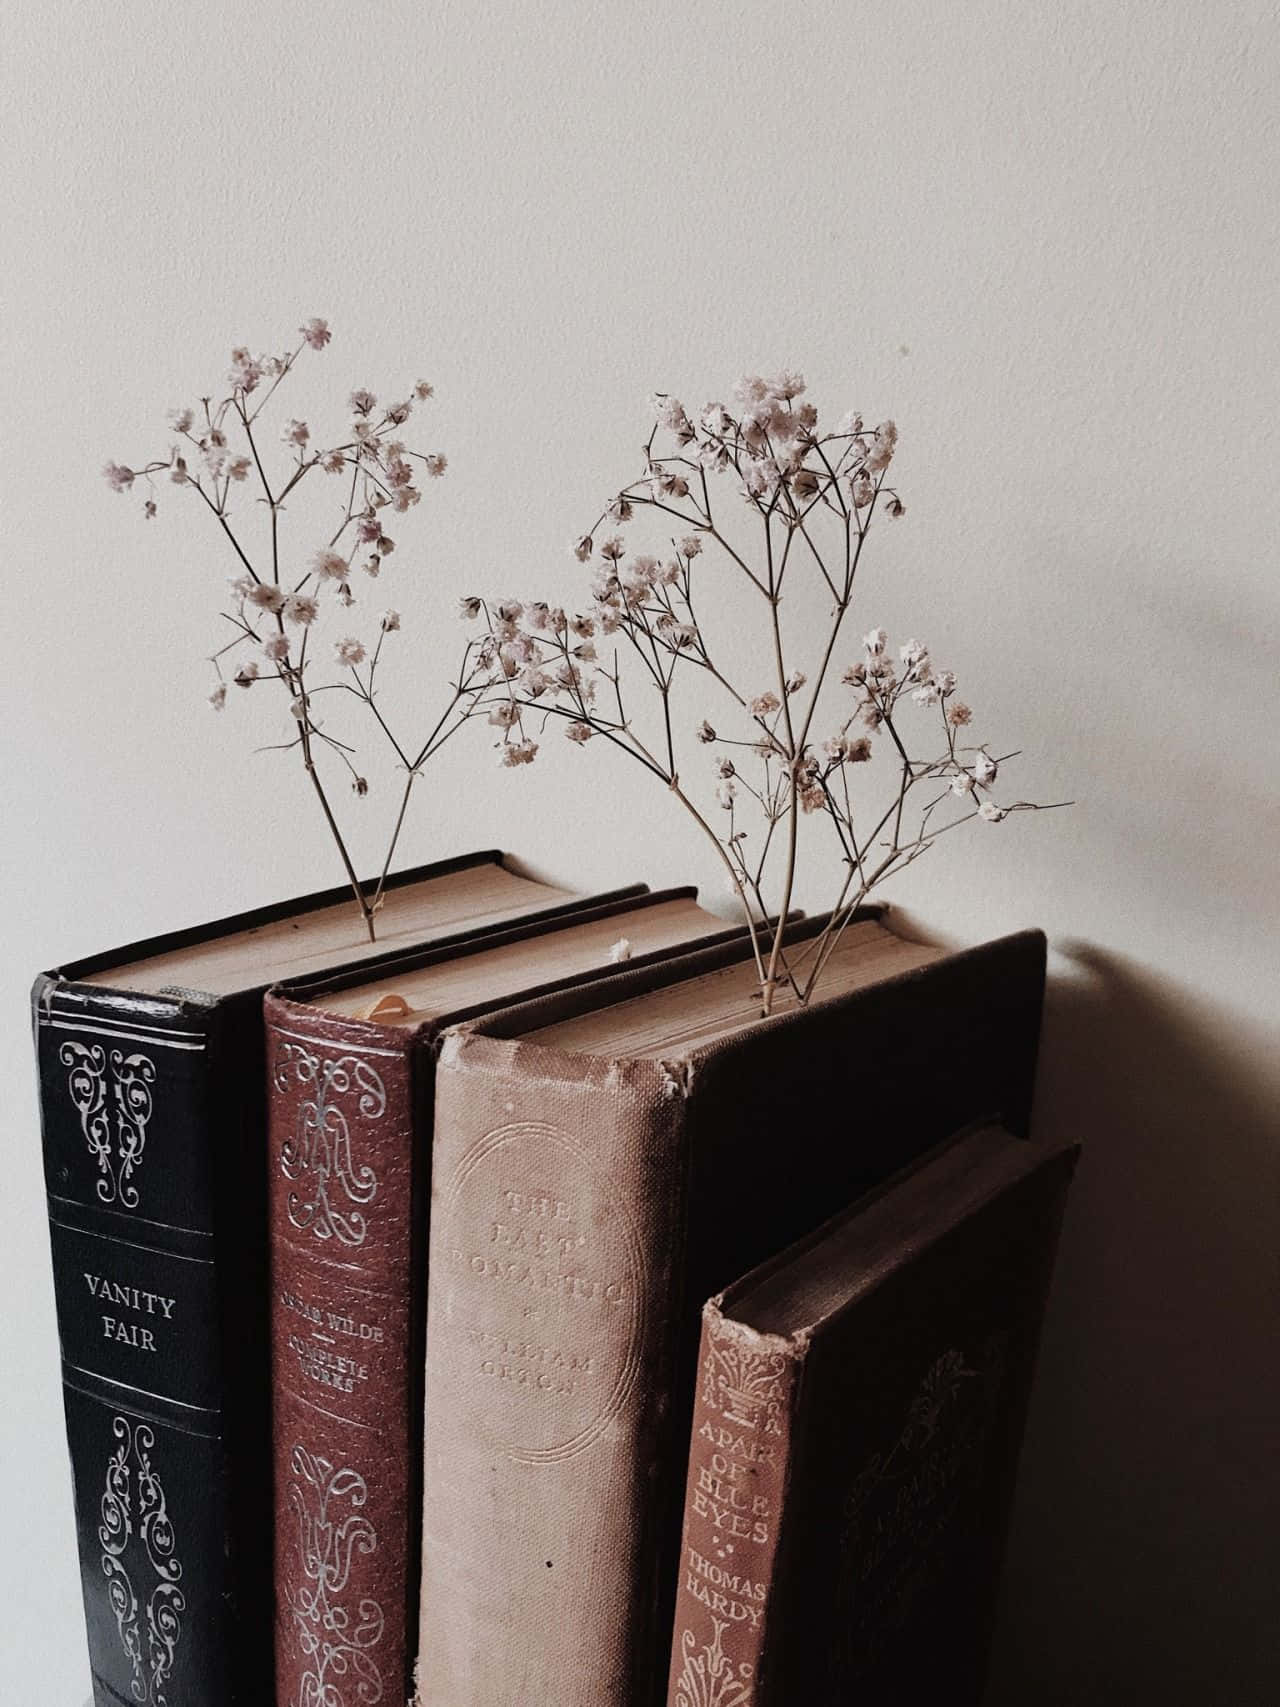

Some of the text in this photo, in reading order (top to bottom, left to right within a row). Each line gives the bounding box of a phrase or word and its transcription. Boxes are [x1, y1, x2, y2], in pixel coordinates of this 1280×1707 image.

[503, 1190, 571, 1222] THE
[84, 1273, 176, 1319] VANITY
[101, 1316, 157, 1351] FAIR
[326, 1312, 384, 1343] WILDE
[300, 1358, 355, 1393] WORKS
[712, 1454, 747, 1481] OF
[692, 1488, 769, 1543] EYES
[687, 1546, 767, 1601] THOMAS
[686, 1570, 764, 1626] HARDY
